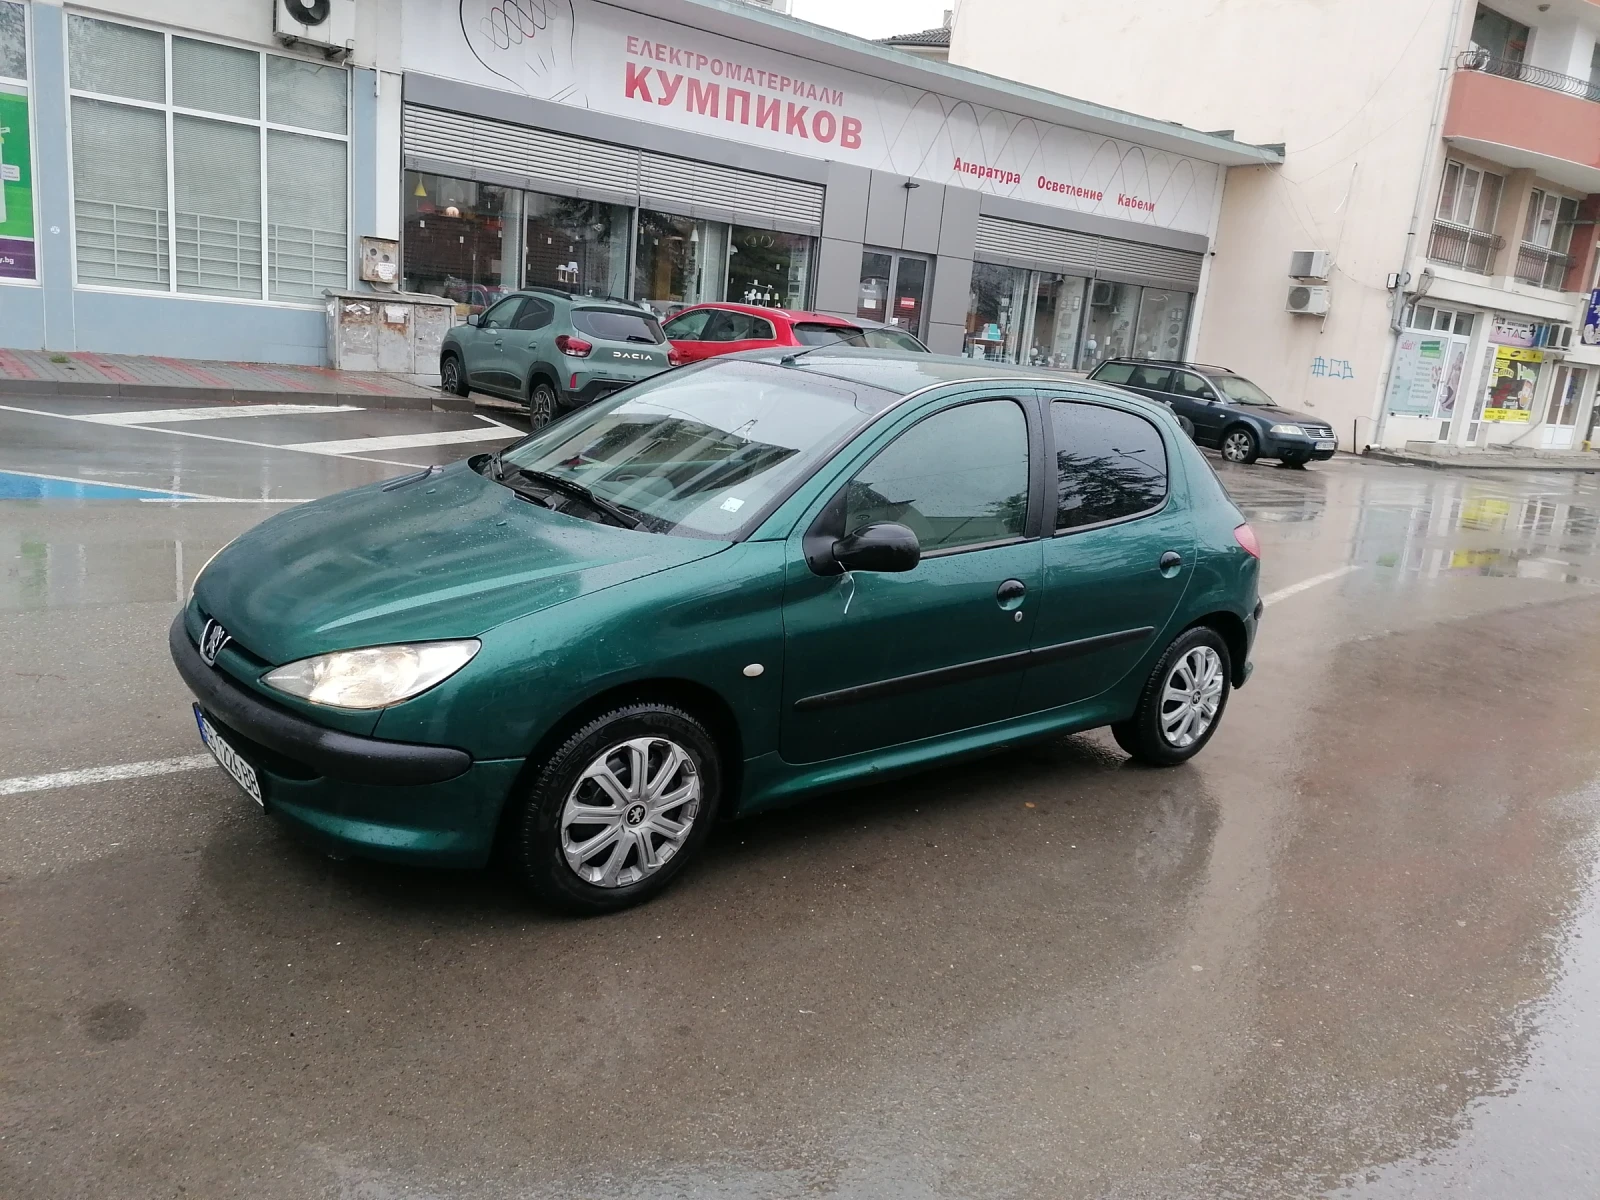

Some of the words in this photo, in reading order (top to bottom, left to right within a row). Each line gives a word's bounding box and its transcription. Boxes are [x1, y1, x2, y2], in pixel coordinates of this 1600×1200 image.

[626, 35, 844, 107] ЕЛЕКТРОМАТЕРИАЛИ
[624, 61, 862, 150] КУМПИКОВ
[953, 157, 1021, 185] Апаратура
[1037, 175, 1103, 202] Осветление
[1117, 193, 1156, 213] Кабели
[612, 351, 653, 361] DACIA
[1495, 325, 1528, 340] V-TAC
